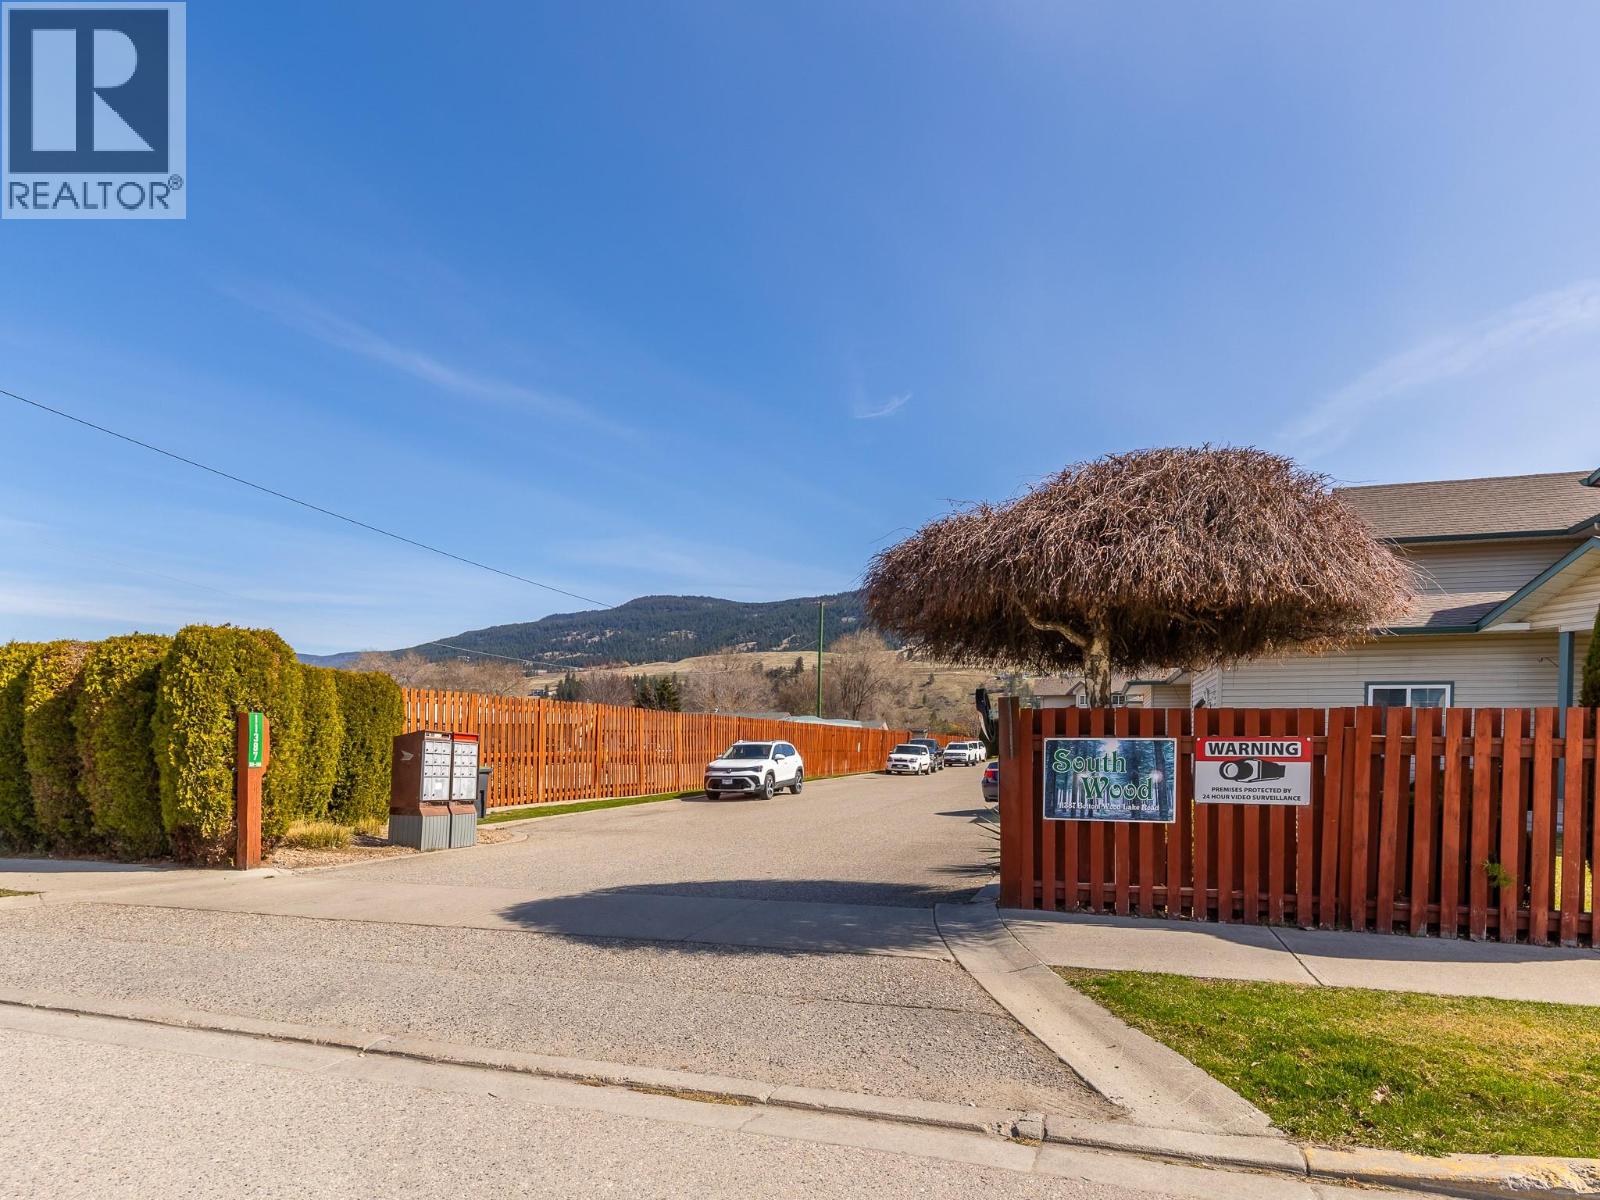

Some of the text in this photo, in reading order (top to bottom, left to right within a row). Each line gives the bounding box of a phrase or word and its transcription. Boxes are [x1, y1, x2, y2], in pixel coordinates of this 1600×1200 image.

[1208, 742, 1299, 756] WARNING
[1052, 748, 1128, 773] South
[1081, 776, 1154, 800] Wood
[1123, 803, 1140, 811] Lake
[1141, 803, 1160, 811] Road
